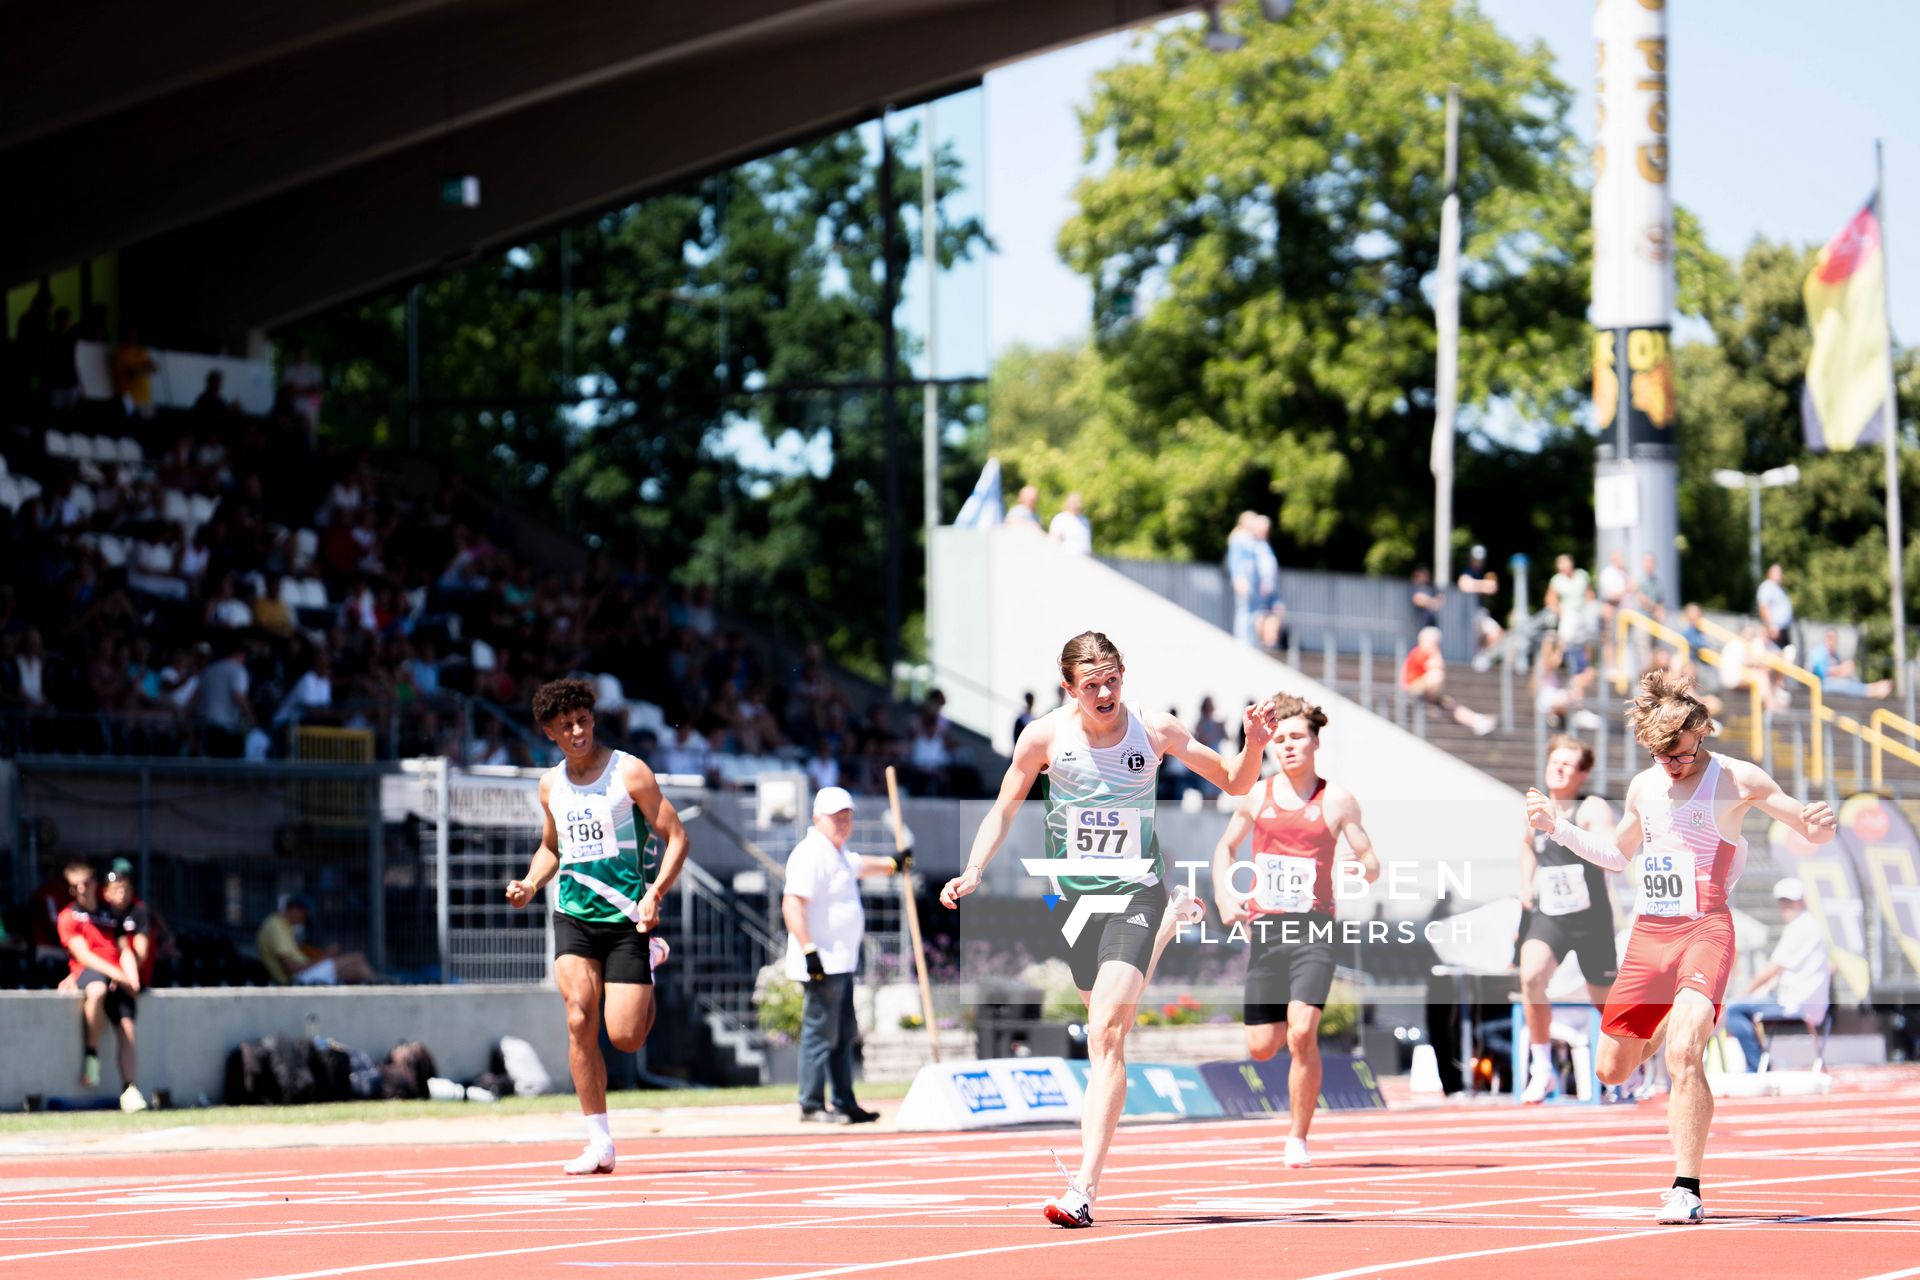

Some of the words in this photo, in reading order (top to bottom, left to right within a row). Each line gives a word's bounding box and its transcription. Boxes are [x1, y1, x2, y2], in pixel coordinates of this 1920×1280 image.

[566, 808, 593, 822] GLS
[567, 821, 604, 843] 198
[1076, 828, 1128, 853] 577
[1644, 856, 1673, 872] GLS
[1643, 874, 1683, 898] 990
